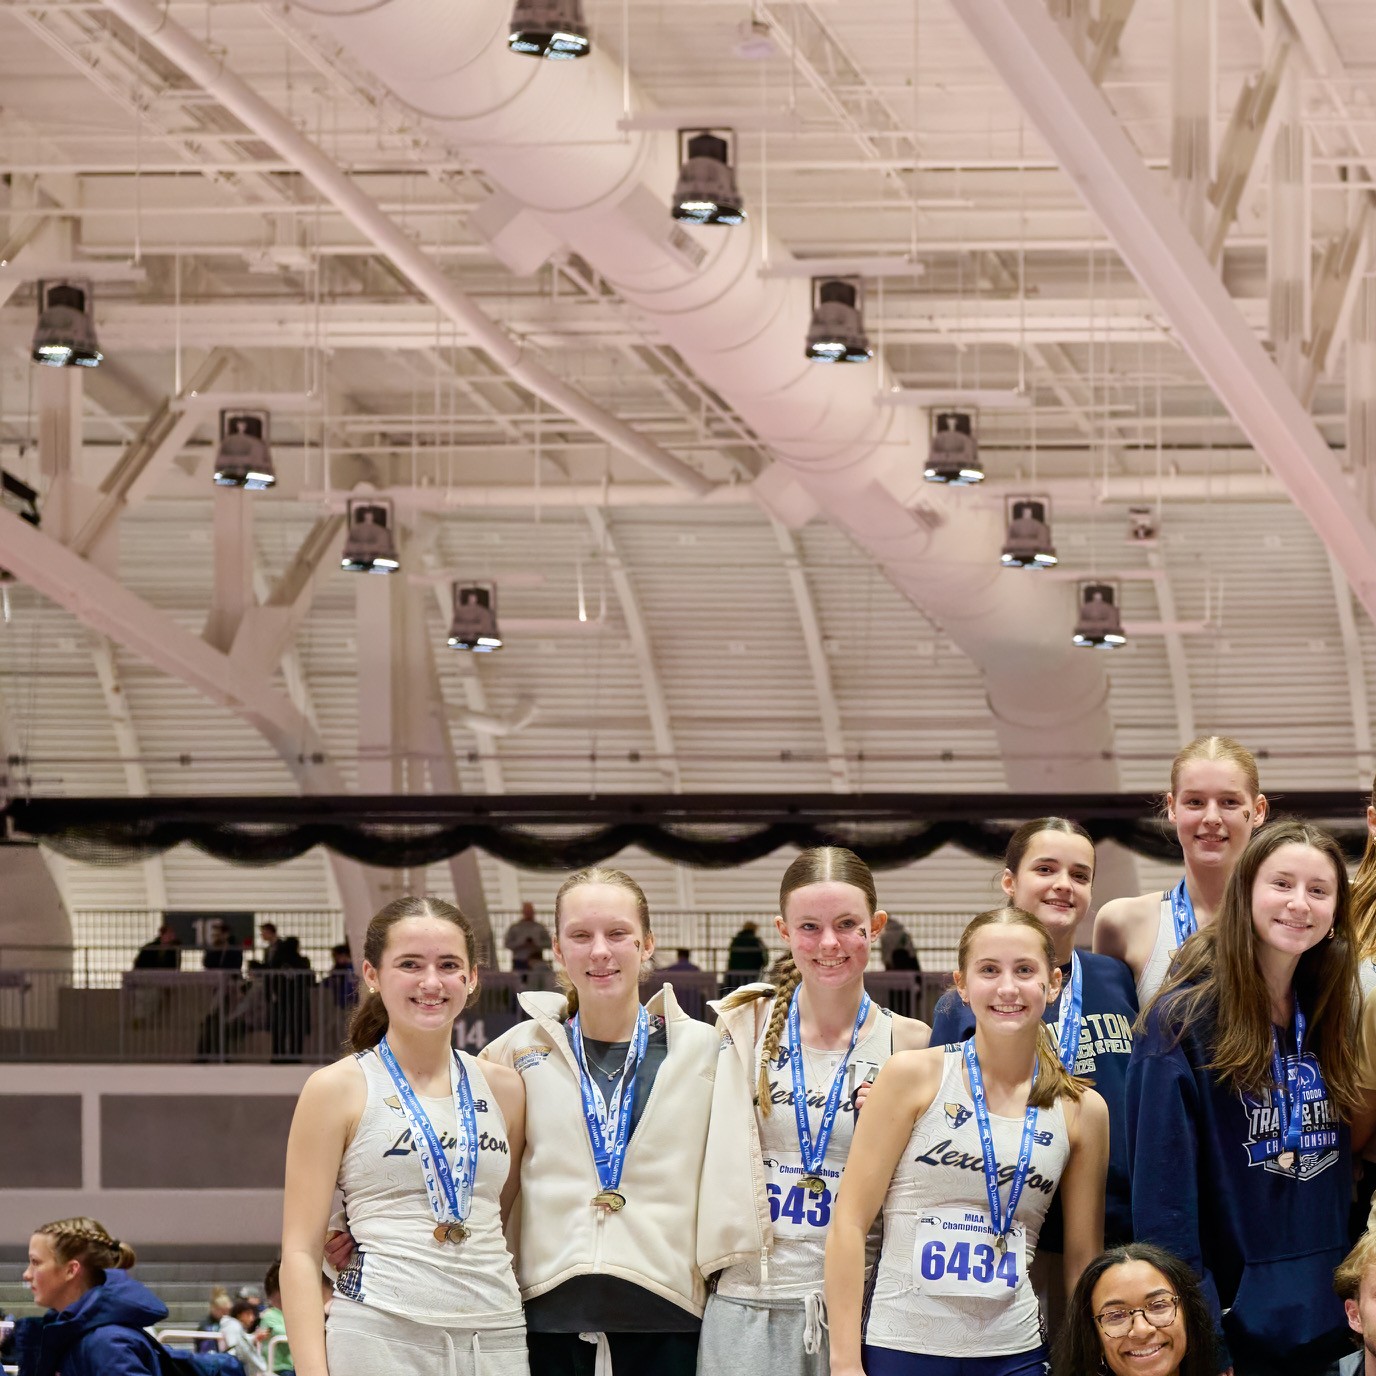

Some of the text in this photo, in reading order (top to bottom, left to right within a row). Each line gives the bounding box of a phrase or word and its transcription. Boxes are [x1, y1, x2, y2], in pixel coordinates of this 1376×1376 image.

[453, 1022, 487, 1048] 14
[383, 1126, 508, 1158] Linton
[1266, 1132, 1336, 1153] CHIONSHIP
[779, 1165, 840, 1179] Chamships
[914, 1139, 1054, 1195] Lexigon
[766, 1183, 836, 1228] 643
[964, 1213, 984, 1223] MIAA
[942, 1221, 997, 1236] Championsh
[921, 1241, 1019, 1288] 6434
